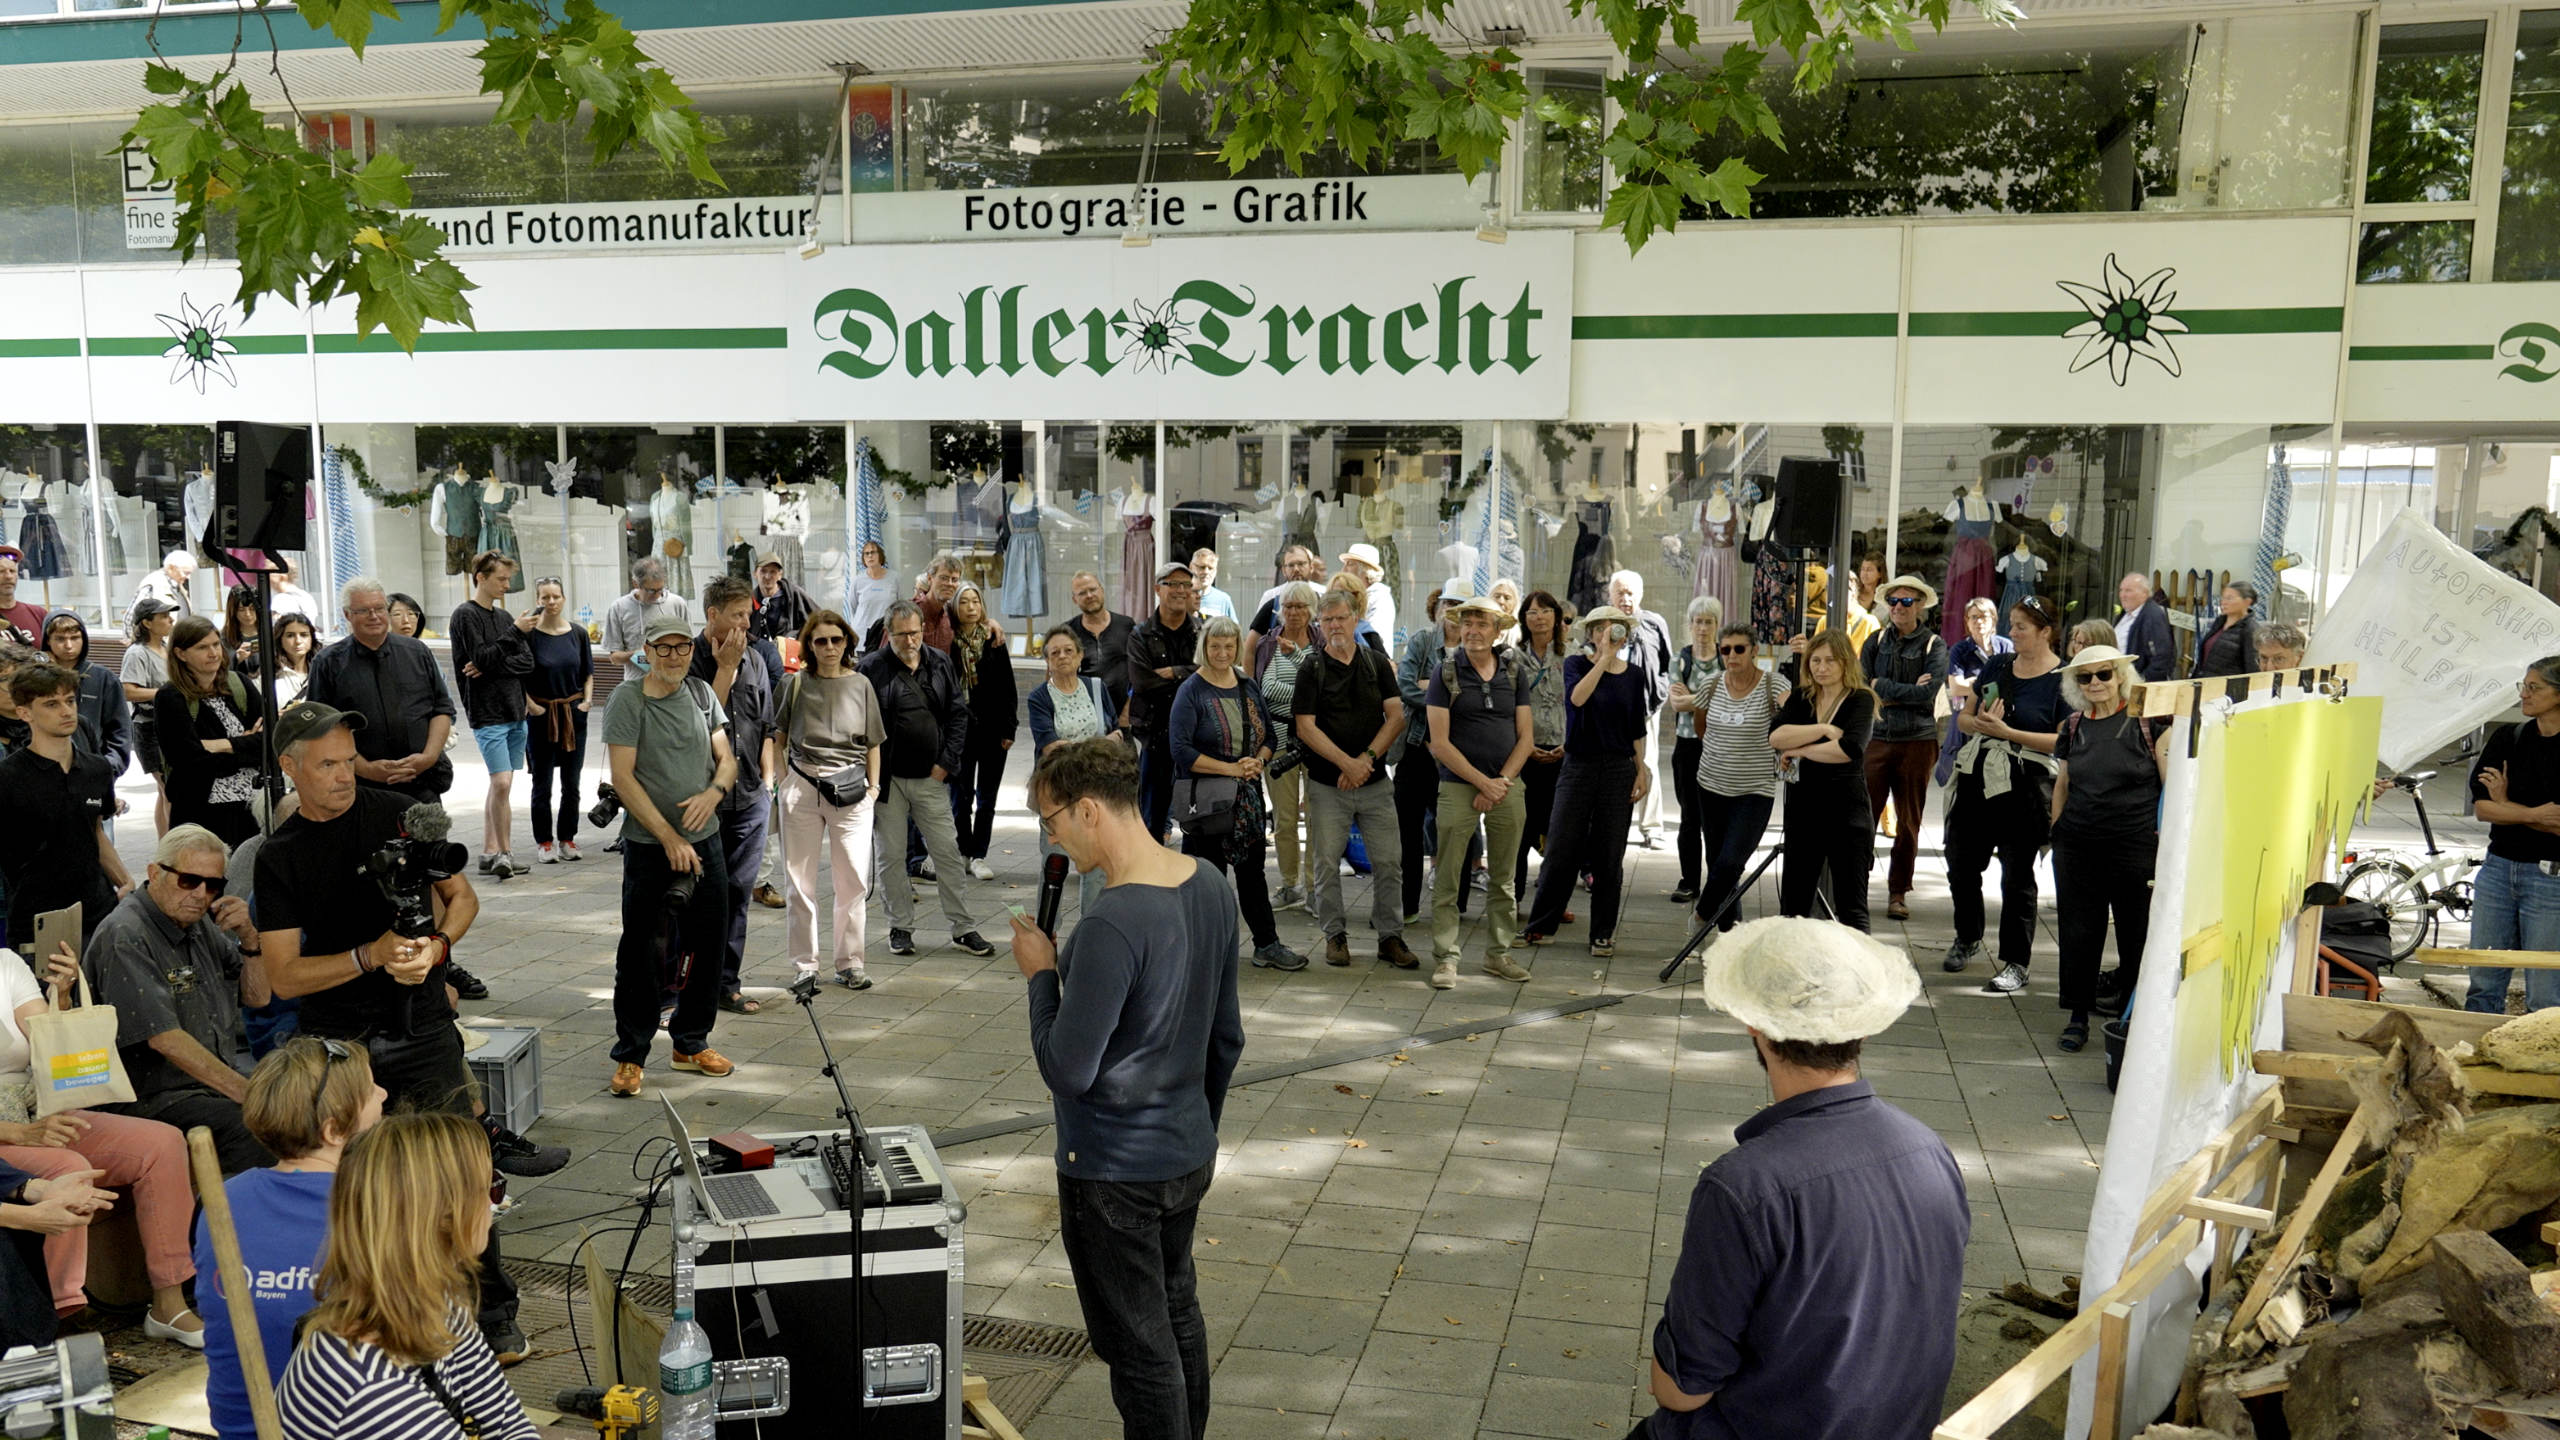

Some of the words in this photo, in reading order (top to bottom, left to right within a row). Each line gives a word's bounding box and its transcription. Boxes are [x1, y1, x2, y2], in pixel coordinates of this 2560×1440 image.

[127, 206, 165, 228] fine
[506, 203, 812, 244] Fotomanufaktur
[1233, 181, 1368, 224] Grafik
[814, 284, 1130, 380] Daller
[1170, 275, 1543, 377] Tracht
[2422, 611, 2480, 654] IST
[255, 1290, 287, 1300] Bayern
